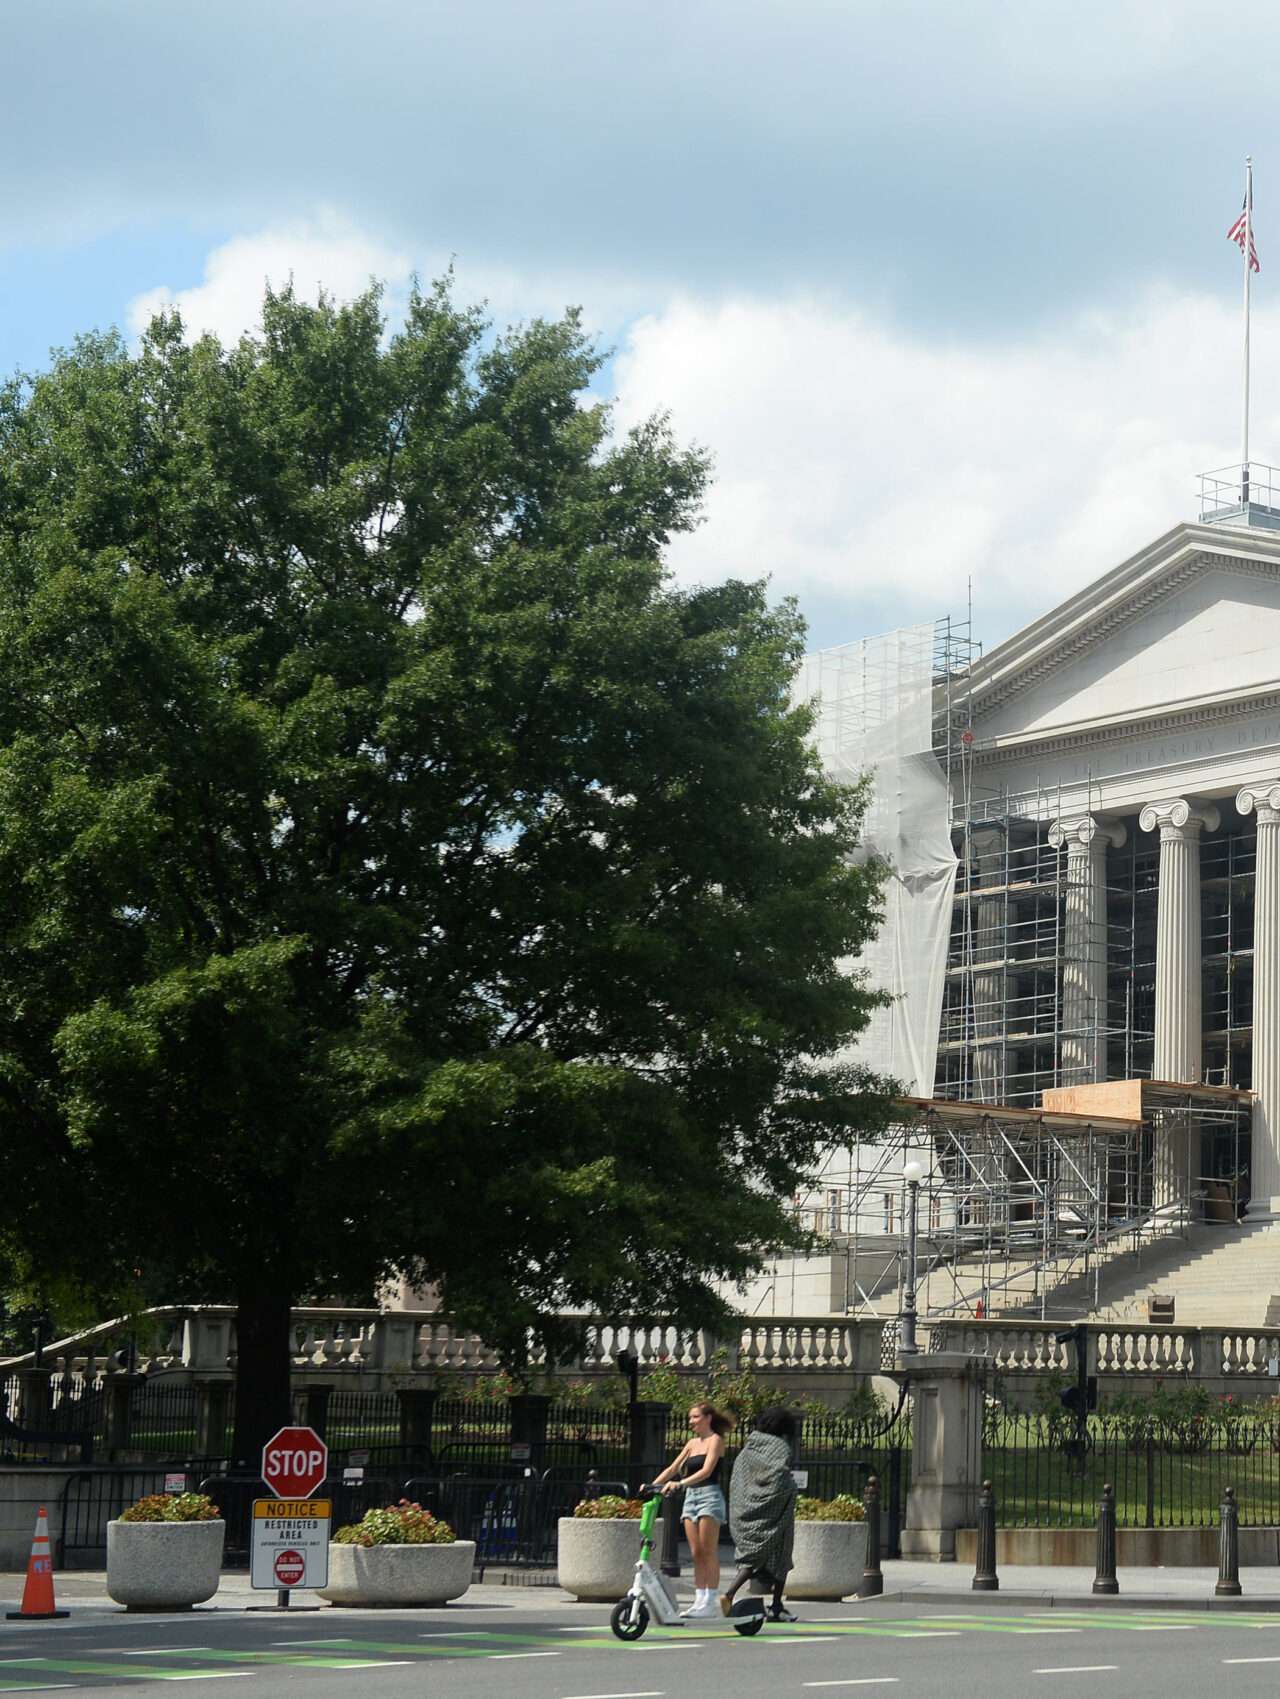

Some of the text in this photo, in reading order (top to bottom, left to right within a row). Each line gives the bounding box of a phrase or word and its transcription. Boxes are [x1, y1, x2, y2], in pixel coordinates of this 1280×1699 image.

[1124, 739, 1216, 767] TREASURY
[267, 1450, 323, 1477] STOP
[266, 1503, 318, 1517] NOTICE
[264, 1520, 319, 1529] RESTRICTED
[279, 1530, 303, 1540] AREA
